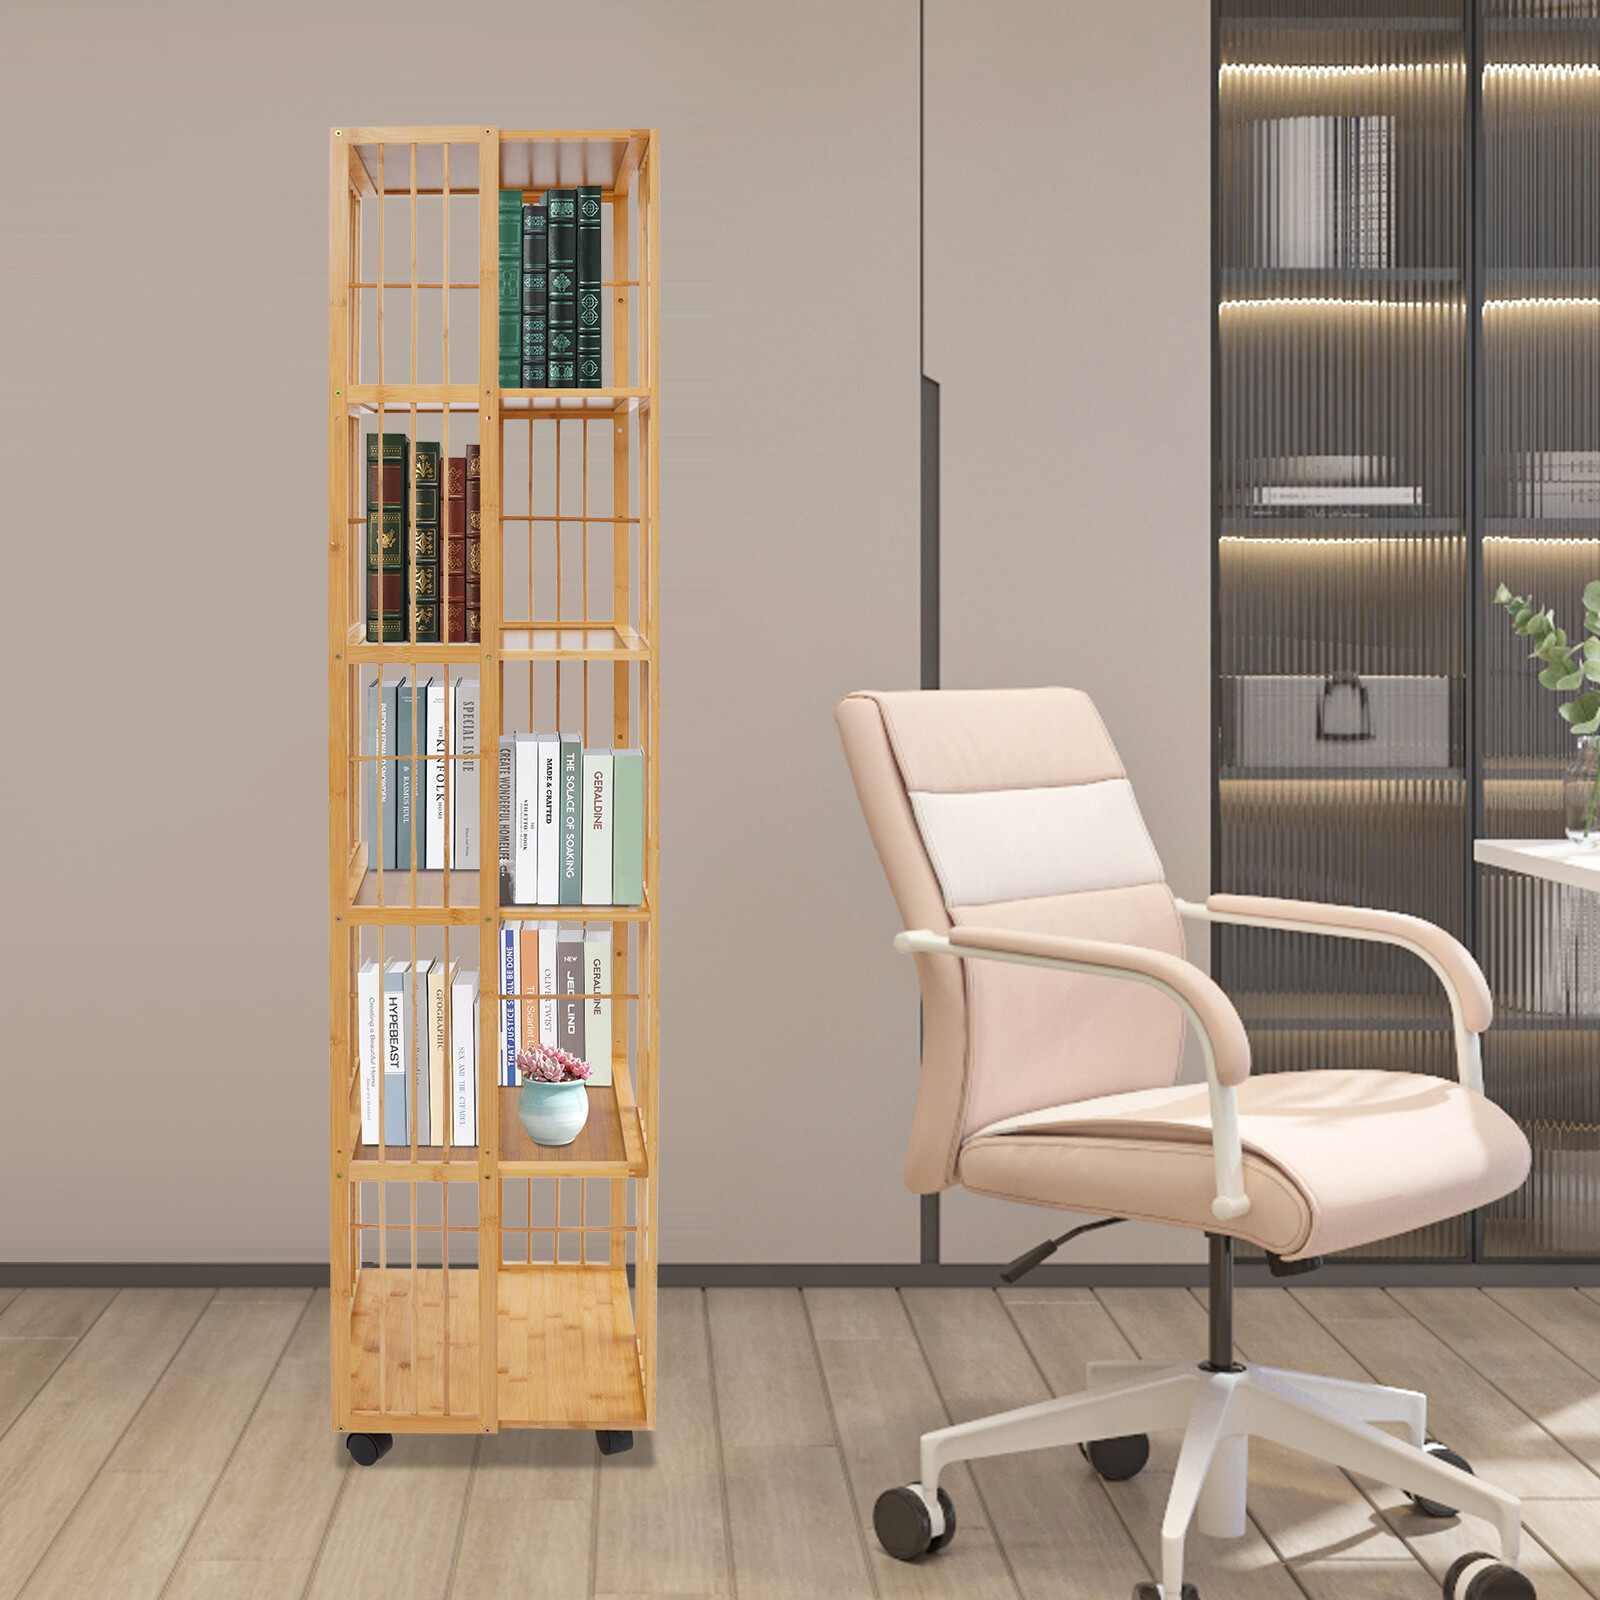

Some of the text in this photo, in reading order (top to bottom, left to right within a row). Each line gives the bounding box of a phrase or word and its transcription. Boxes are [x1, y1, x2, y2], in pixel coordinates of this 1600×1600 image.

[462, 701, 475, 772] SPECIAL ISUE
[402, 805, 410, 824] JUUL
[499, 748, 511, 860] CREATE WONDERFUL HOMELIFE
[545, 789, 553, 824] CRAFTED
[565, 753, 575, 878] THE SOLACE OF SOAKING
[593, 771, 603, 830] GERALDINE
[389, 997, 399, 1068] HYPEBEAST
[505, 946, 515, 1067] THAT JUSTICE SALL BE DONE
[526, 1004, 535, 1037] Scarlet
[544, 1004, 552, 1032] TWIST
[567, 1004, 575, 1034] LIND
